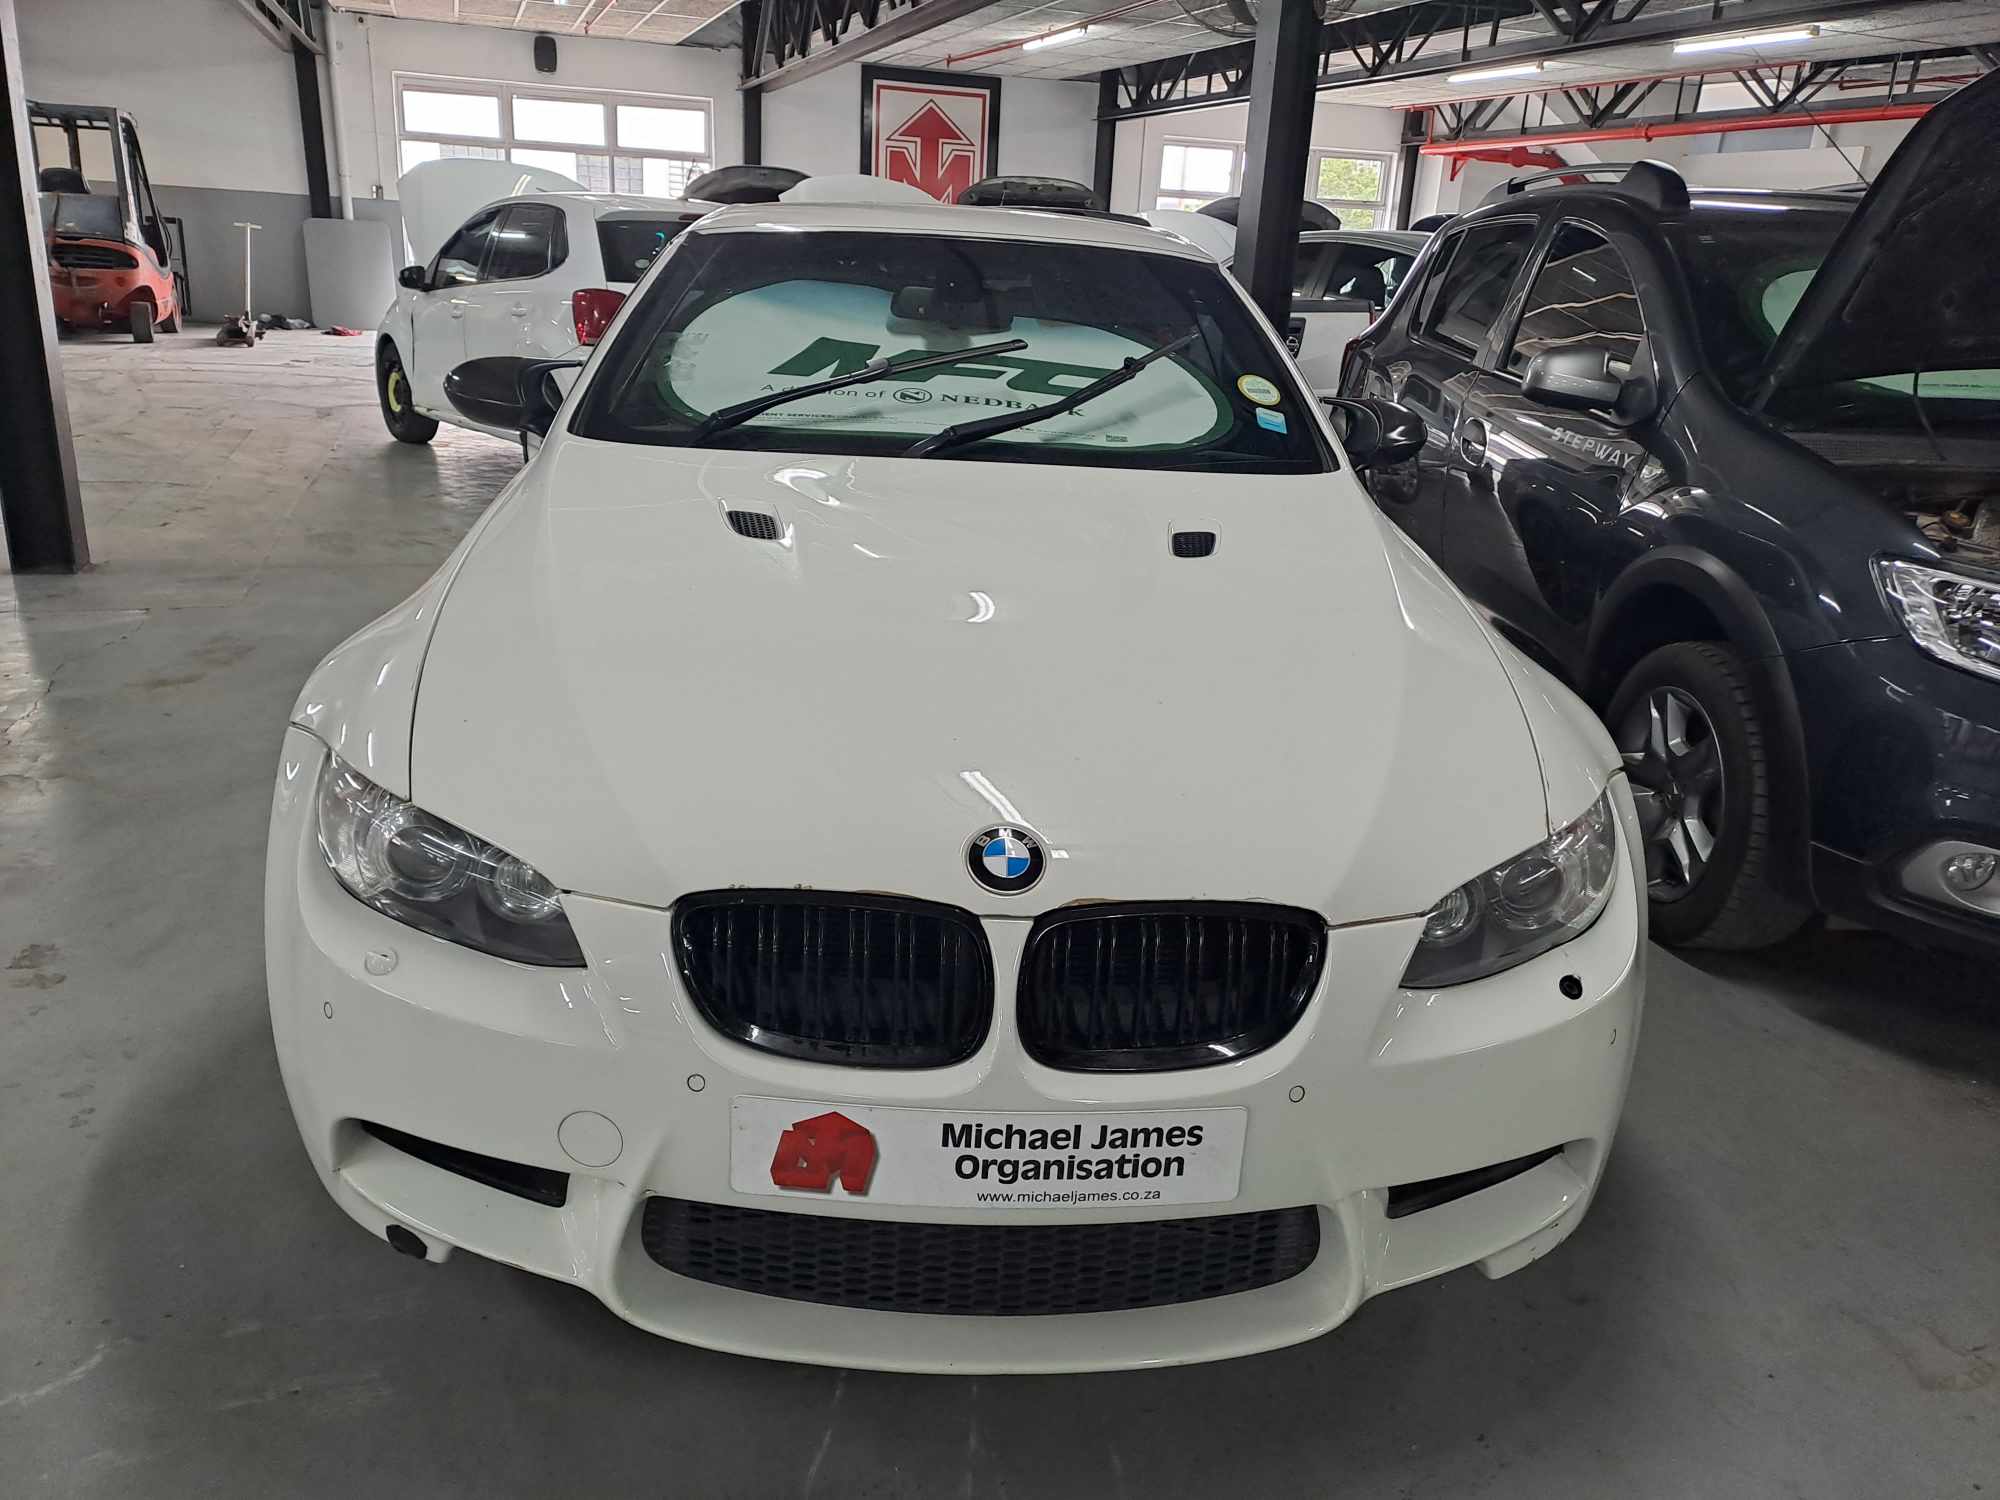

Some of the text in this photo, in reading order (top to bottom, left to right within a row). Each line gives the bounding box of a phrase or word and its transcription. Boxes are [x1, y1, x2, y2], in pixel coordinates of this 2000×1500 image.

[760, 383, 775, 392] A
[865, 390, 886, 399] of
[940, 393, 1086, 417] NEDBAK
[1551, 427, 1635, 468] STEPWAY
[975, 828, 1038, 849] BMW
[941, 1123, 1204, 1150] Michael James
[954, 1153, 1185, 1185] Organisation
[976, 1189, 1162, 1204] www.michaeljames.co.za
